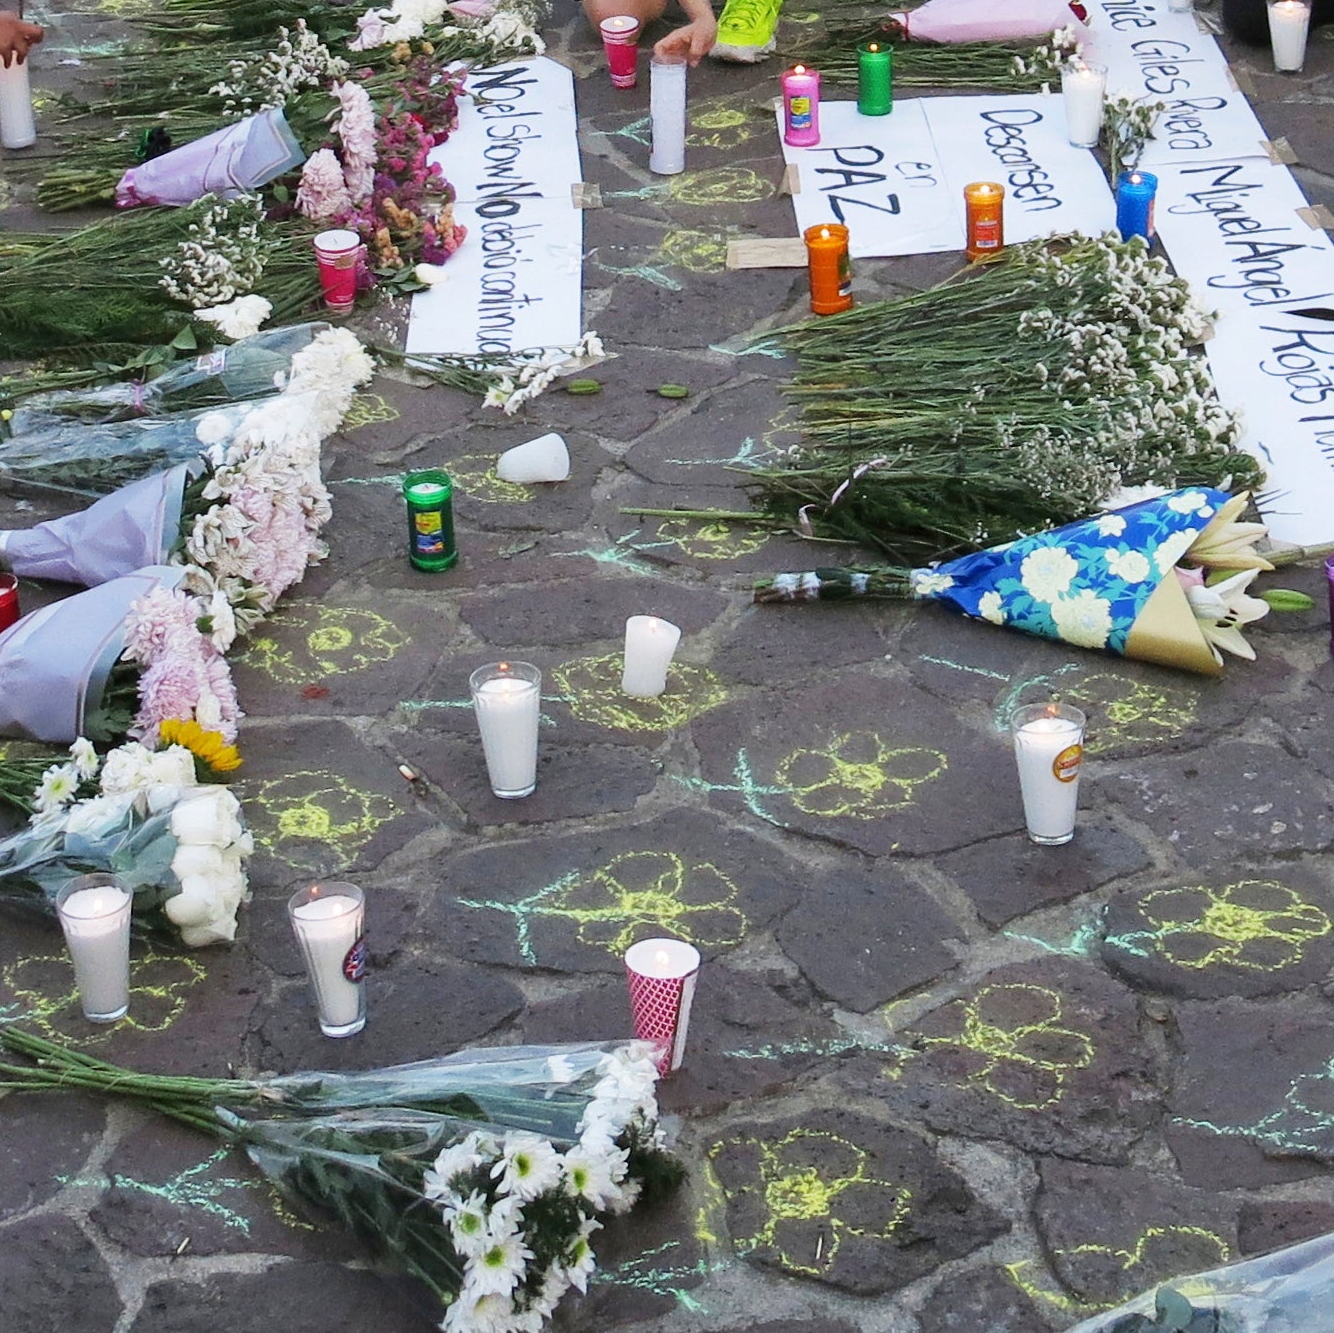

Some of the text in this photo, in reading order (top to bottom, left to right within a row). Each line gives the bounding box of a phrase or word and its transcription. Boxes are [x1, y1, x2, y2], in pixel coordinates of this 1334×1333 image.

[1131, 39, 1205, 95] Giles
[1164, 96, 1228, 150] Rivera
[483, 124, 542, 180] show
[894, 161, 938, 188] en
[979, 109, 1063, 213] Descansen
[475, 182, 543, 219] No
[805, 145, 901, 224] PAZ
[1168, 165, 1291, 237] Miguel
[481, 222, 543, 268] debió
